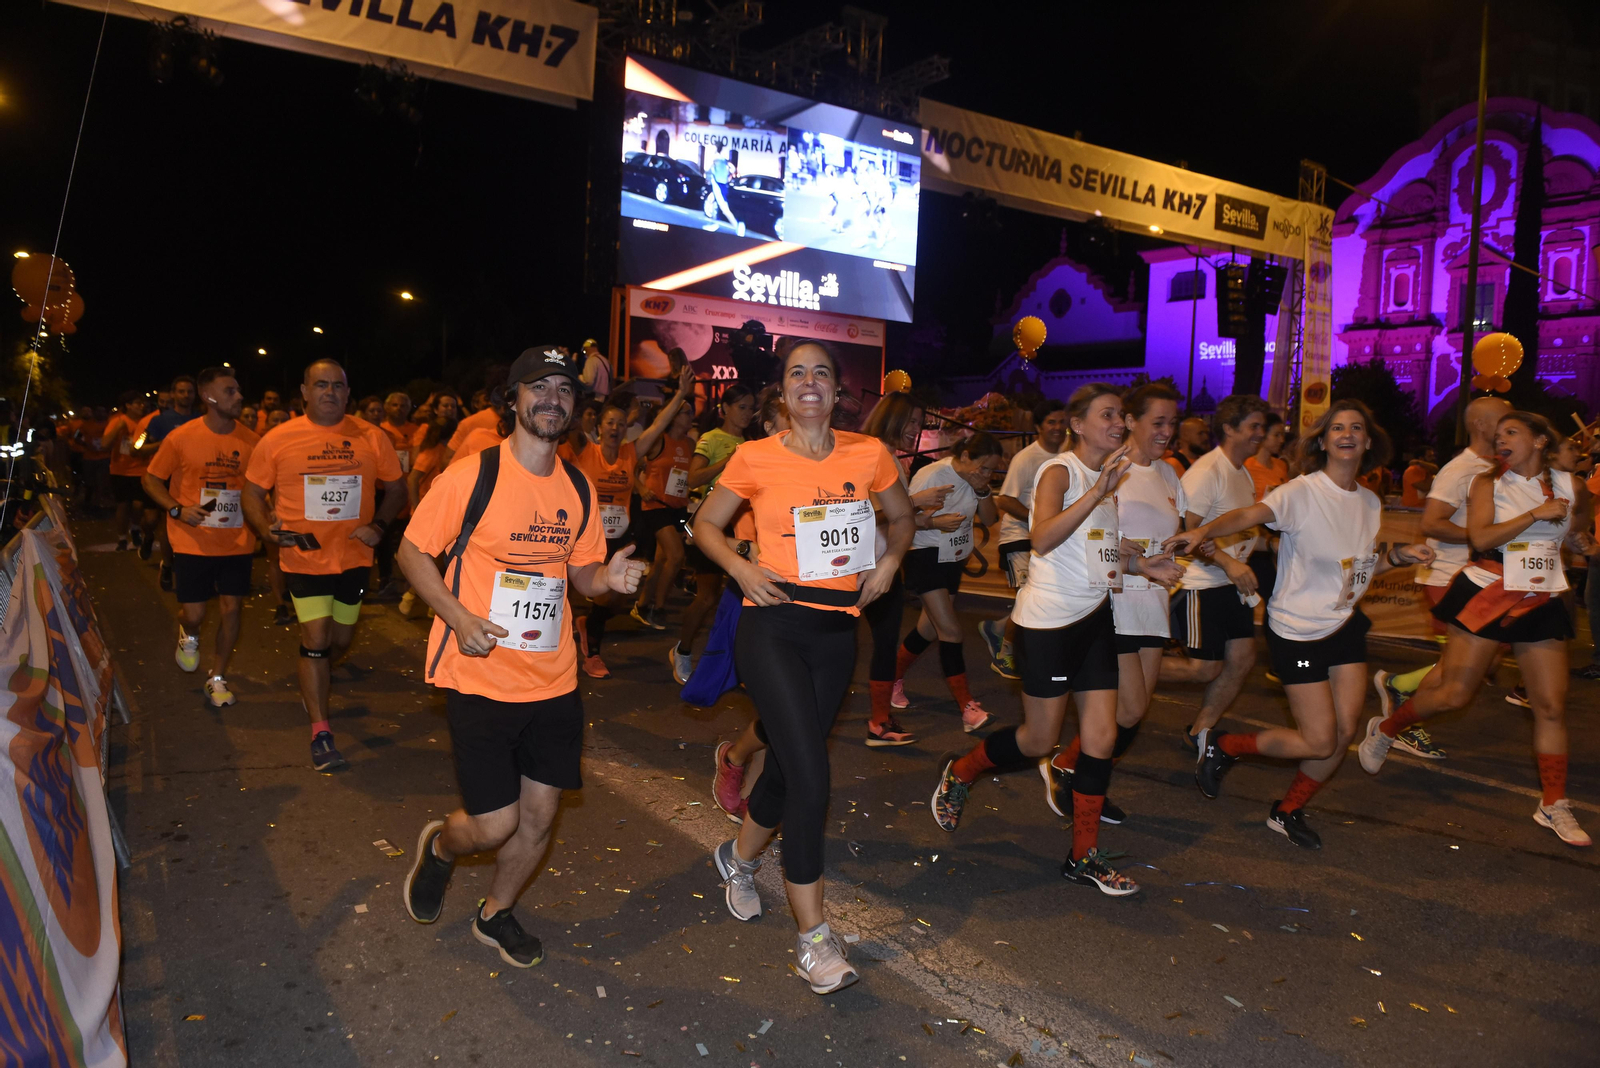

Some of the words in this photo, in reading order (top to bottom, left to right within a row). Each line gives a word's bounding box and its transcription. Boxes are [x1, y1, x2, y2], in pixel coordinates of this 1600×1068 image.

[684, 131, 729, 148] COLEGIO
[925, 127, 1061, 184] NOCTURNA
[1068, 164, 1156, 207] SEVILLA
[683, 304, 698, 313] ABC
[705, 308, 736, 319] Cruzcampo
[321, 491, 349, 502] 4237
[528, 524, 571, 535] NOCTURNA
[509, 532, 547, 543] SEVILLA
[820, 526, 860, 548] 9018
[949, 533, 970, 547] 16592
[1520, 557, 1554, 571] 15619
[512, 599, 557, 621] 11574
